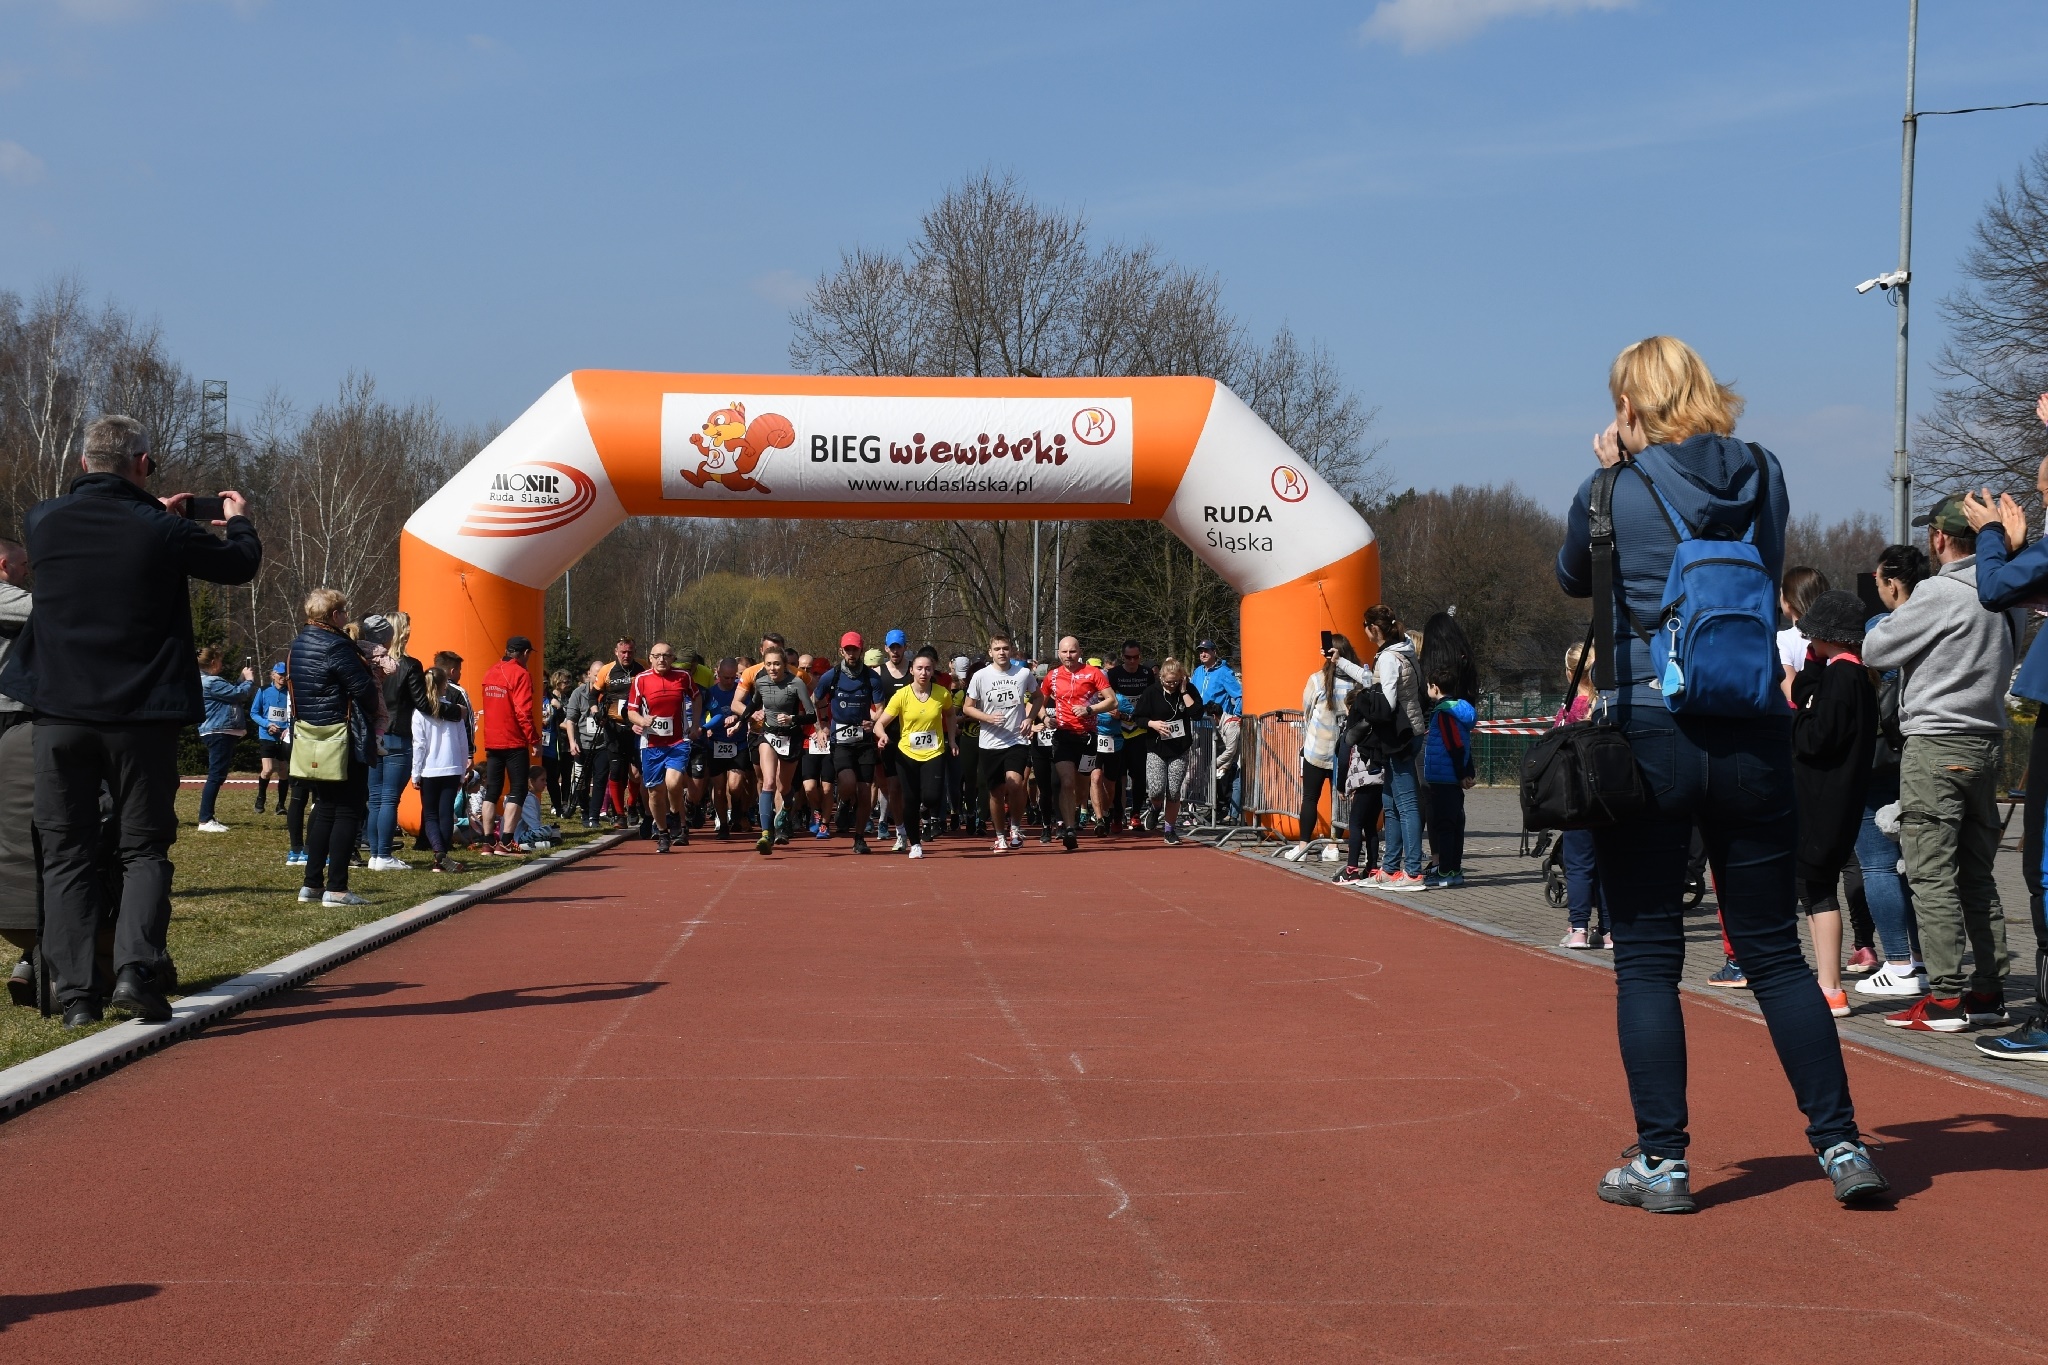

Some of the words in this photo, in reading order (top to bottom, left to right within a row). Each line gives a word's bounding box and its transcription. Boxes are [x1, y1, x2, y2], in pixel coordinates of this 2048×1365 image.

[811, 434, 881, 463] BIEG
[889, 430, 1069, 466] wiewiórki
[491, 473, 560, 494] MOSiR
[847, 475, 1033, 495] www.rudaslaska.pl
[489, 492, 515, 502] Ruda
[520, 490, 560, 506] Śląska
[1204, 505, 1273, 523] RUDA
[1206, 527, 1273, 554] Śląska
[992, 679, 1018, 687] VINTAGE
[996, 690, 1014, 703] 275
[272, 709, 285, 718] 308
[652, 720, 669, 730] 290
[841, 728, 859, 738] 292
[915, 734, 932, 746] 273
[718, 744, 733, 754] 252
